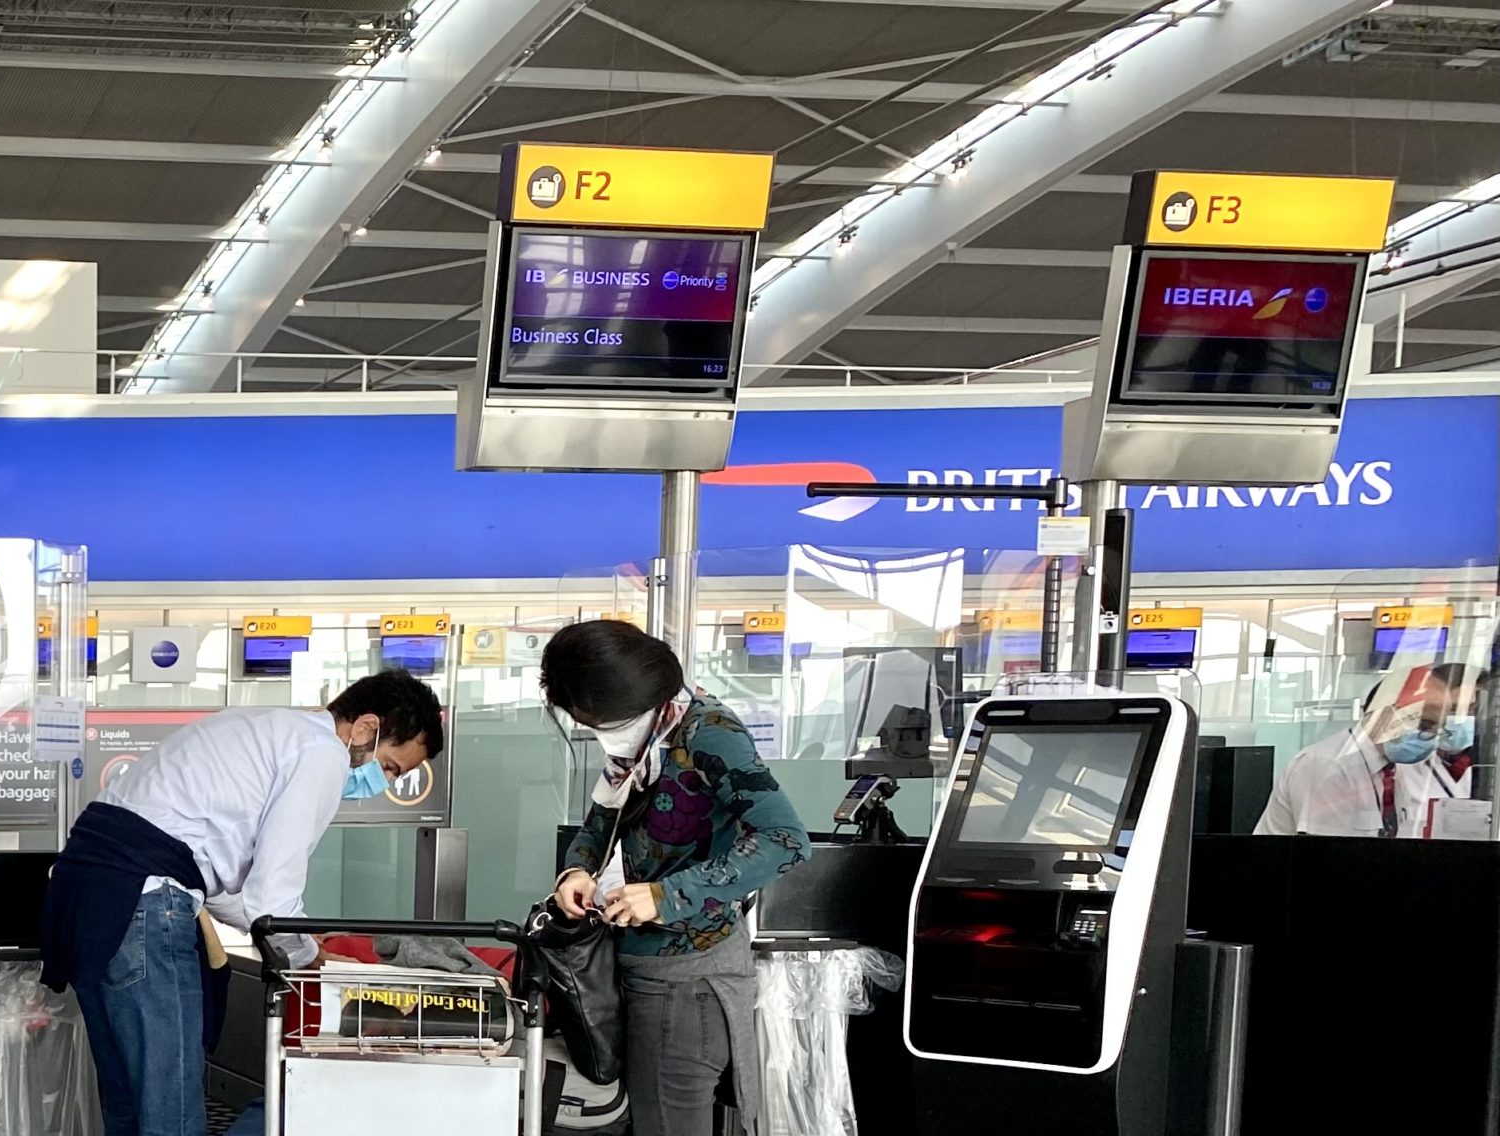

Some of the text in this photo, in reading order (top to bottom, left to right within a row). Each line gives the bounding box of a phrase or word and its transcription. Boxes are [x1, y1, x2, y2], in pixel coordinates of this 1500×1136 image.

[575, 171, 611, 201] F2
[1207, 196, 1241, 224] F3
[525, 269, 650, 287] IB BUSINESS
[680, 275, 714, 289] Priority
[1164, 287, 1254, 307] IBERIA
[512, 327, 623, 345] Business Class
[703, 364, 724, 373] 16:23
[397, 620, 414, 629] E21
[762, 617, 779, 626] E23
[1145, 614, 1164, 623] E25
[260, 622, 277, 631] E20
[100, 729, 130, 741] Liquids
[344, 987, 490, 1014] The End of History
